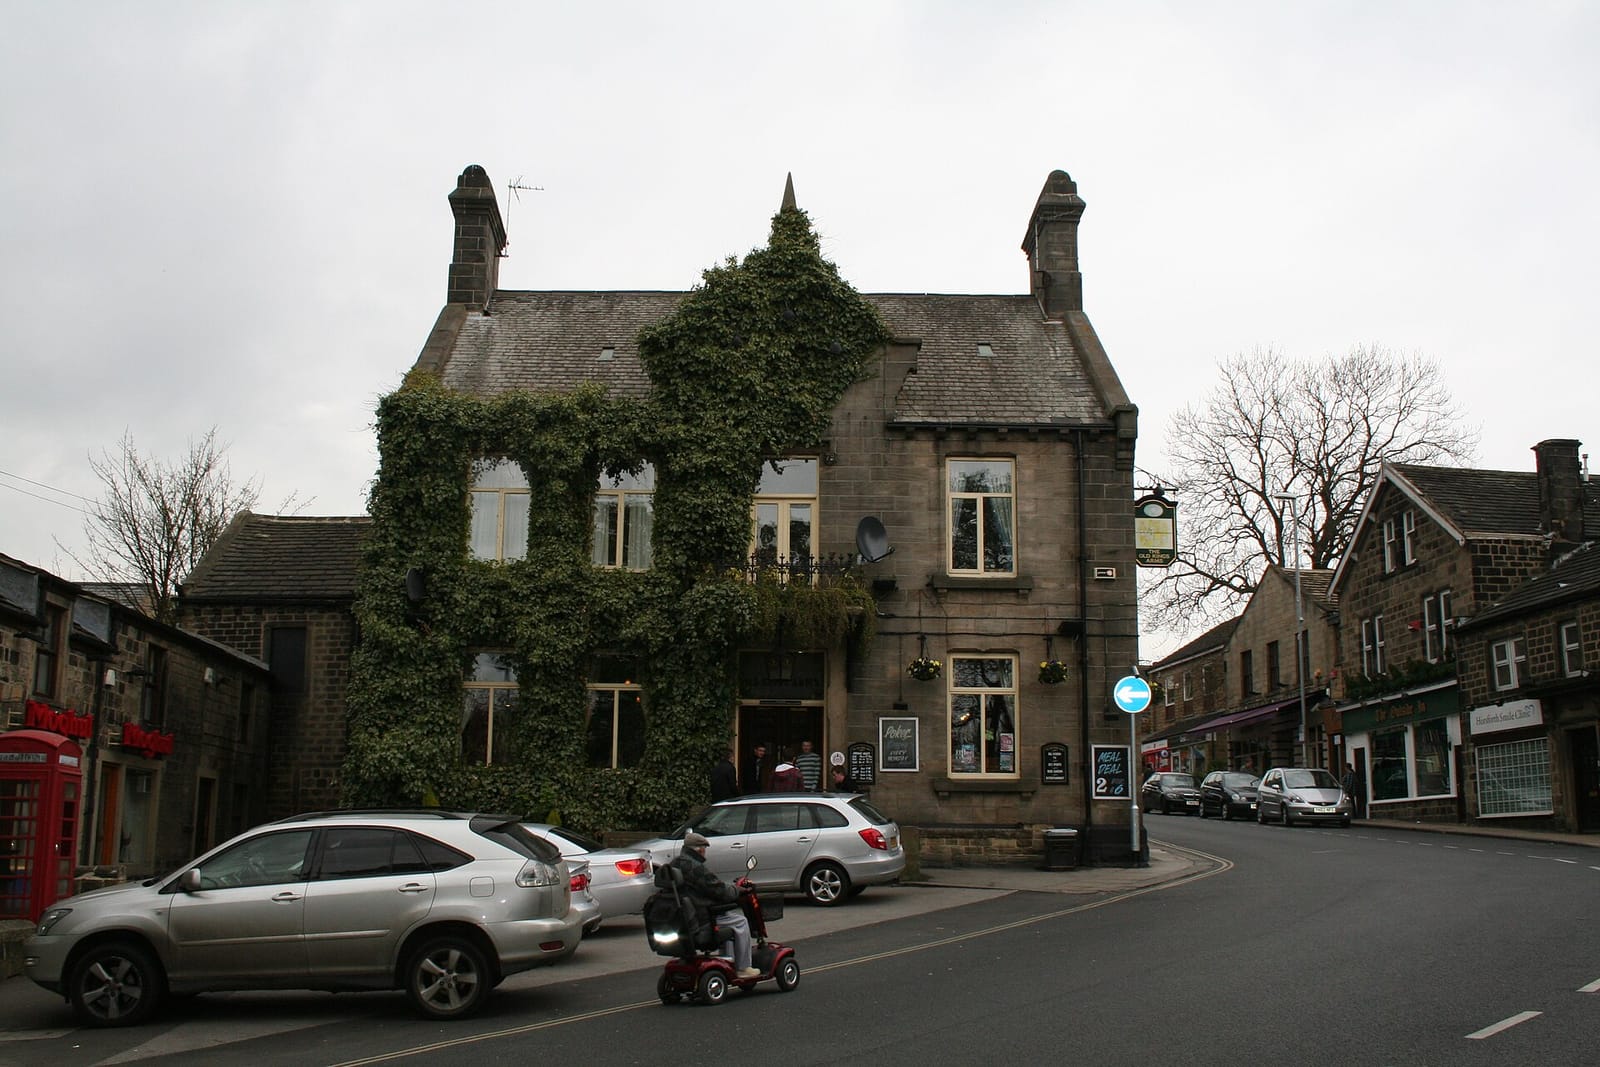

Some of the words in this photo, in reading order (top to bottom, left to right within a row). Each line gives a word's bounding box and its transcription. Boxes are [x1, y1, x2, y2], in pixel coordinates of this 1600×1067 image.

[1097, 751, 1121, 763] MEAL
[1097, 763, 1123, 775] DEAL
[1096, 777, 1108, 793] 2
